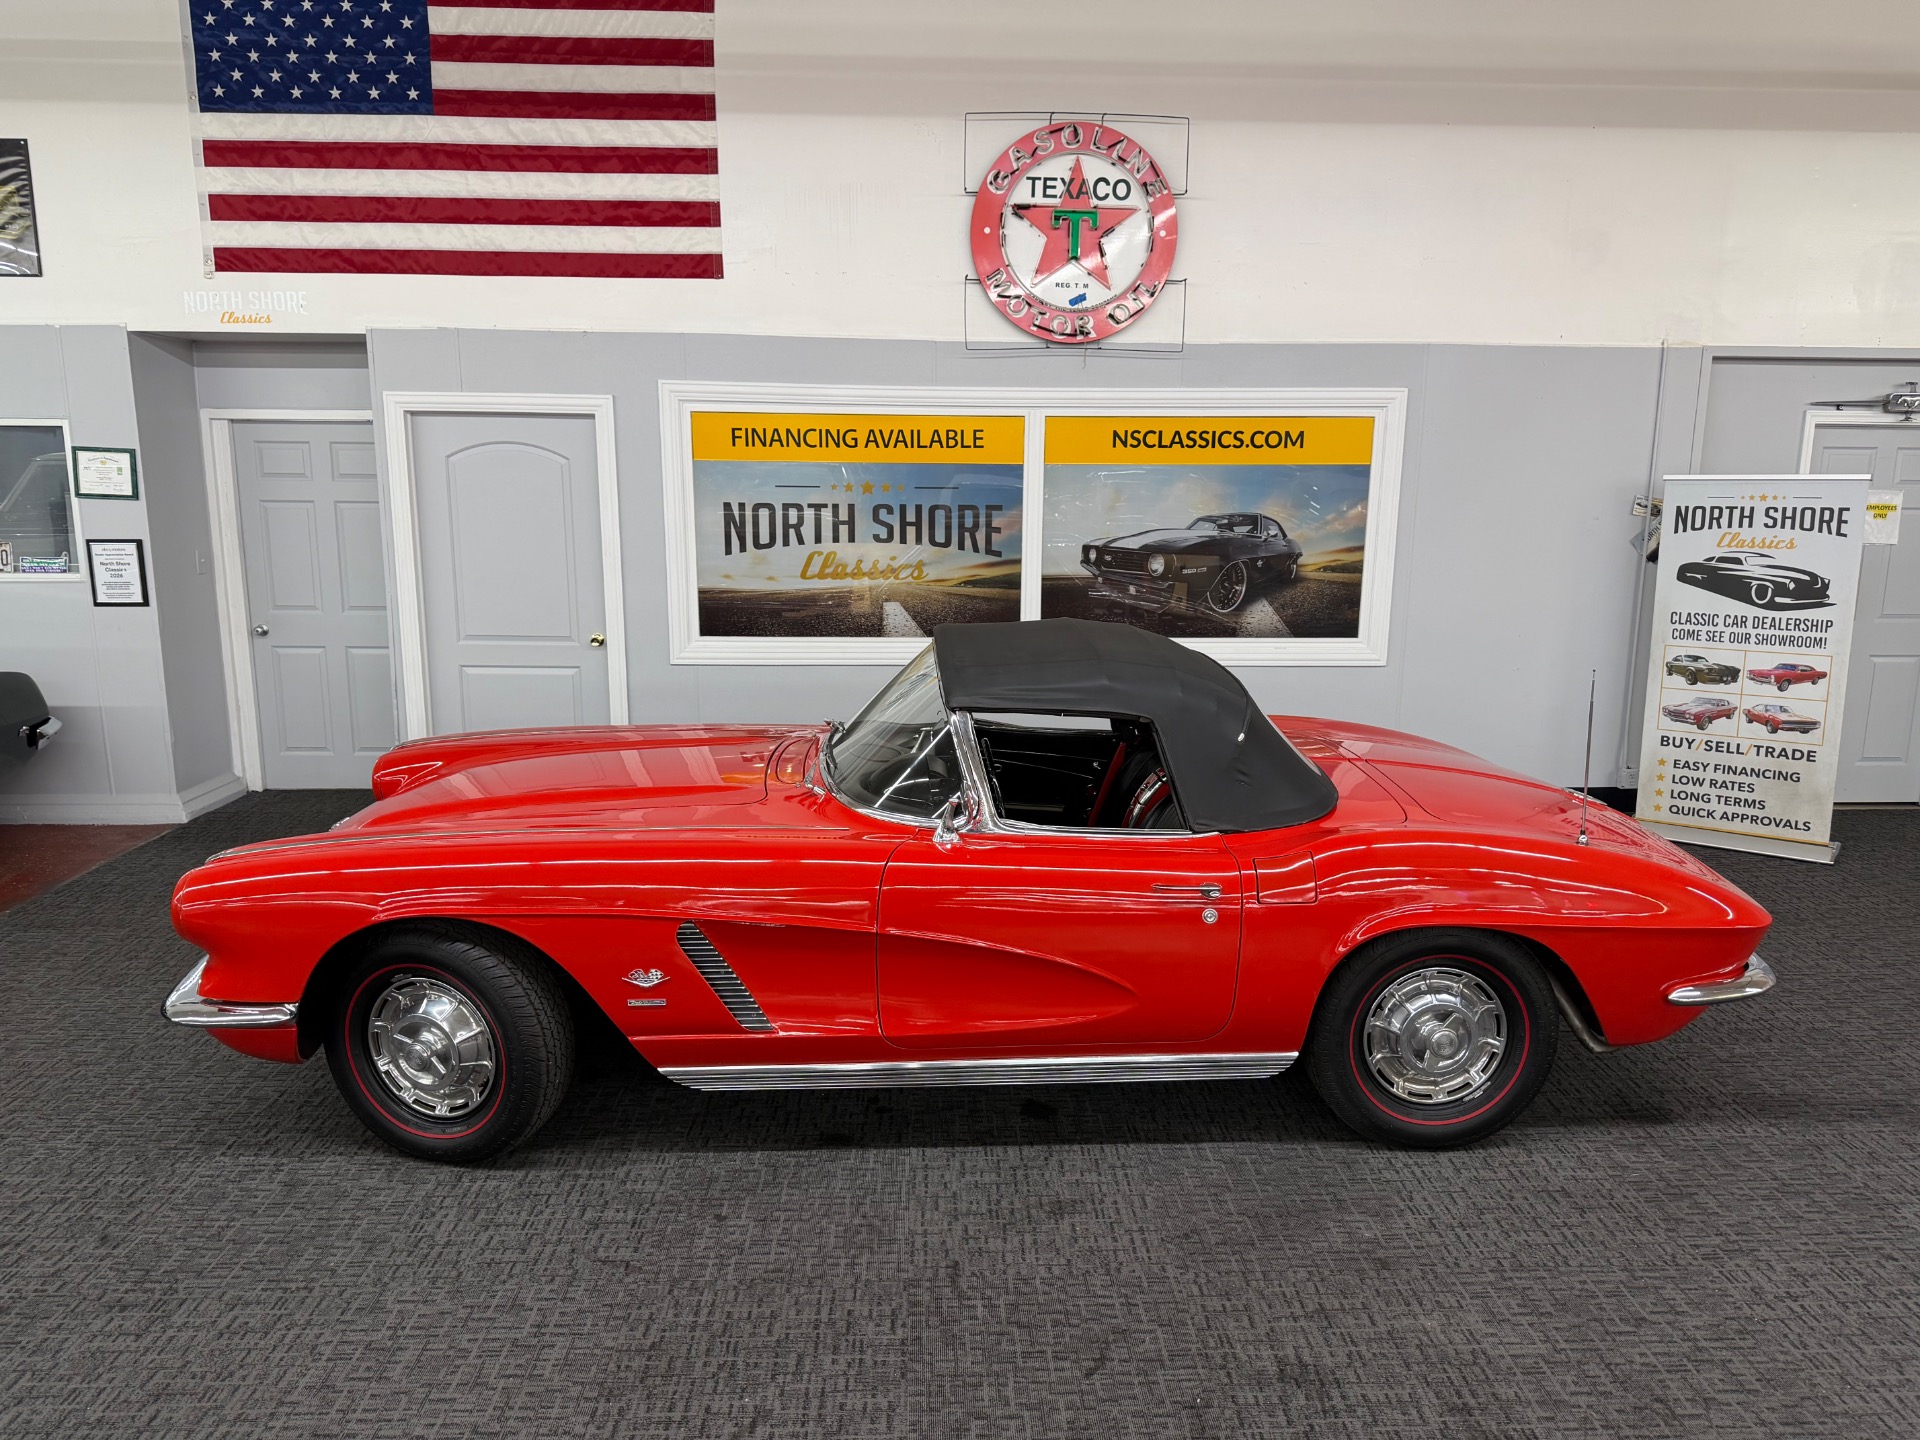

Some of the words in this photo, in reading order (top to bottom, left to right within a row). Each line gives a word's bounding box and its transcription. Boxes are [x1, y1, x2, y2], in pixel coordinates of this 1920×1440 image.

[986, 123, 1168, 203] GASOLINE
[1026, 176, 1132, 201] TEXACO
[183, 290, 242, 314] NORTH
[248, 290, 309, 315] SHORE
[986, 268, 1098, 339] MOTOR
[1108, 280, 1160, 325] OIL
[220, 311, 272, 324] Classics
[731, 427, 859, 448] FINANCING
[864, 428, 985, 449] AVAILABLE
[1112, 429, 1305, 449] NSCLASSICS.COM
[722, 501, 856, 556] NORTH
[872, 503, 1004, 558] SHORE
[1673, 505, 1755, 535] NORTH
[1763, 506, 1851, 538] SHORE
[1716, 532, 1798, 550] Classics
[800, 550, 929, 581] Classics
[1670, 611, 1720, 627] CLASSIC
[1723, 613, 1748, 629] CAR
[1752, 615, 1834, 634] DEALERSHIP
[1671, 628, 1703, 642] COME
[1705, 630, 1725, 643] SEE
[1729, 631, 1751, 645] OUR
[1754, 633, 1828, 650] SHOWROOM!
[1673, 759, 1710, 773] EASY
[1713, 763, 1801, 783] FINANCING
[1671, 774, 1707, 787] LOW
[1709, 778, 1756, 793] RATES
[1670, 789, 1711, 804] LONG
[1715, 794, 1766, 811] TERMS
[1668, 804, 1716, 820] QUICK
[1719, 810, 1812, 832] APPROVALS
